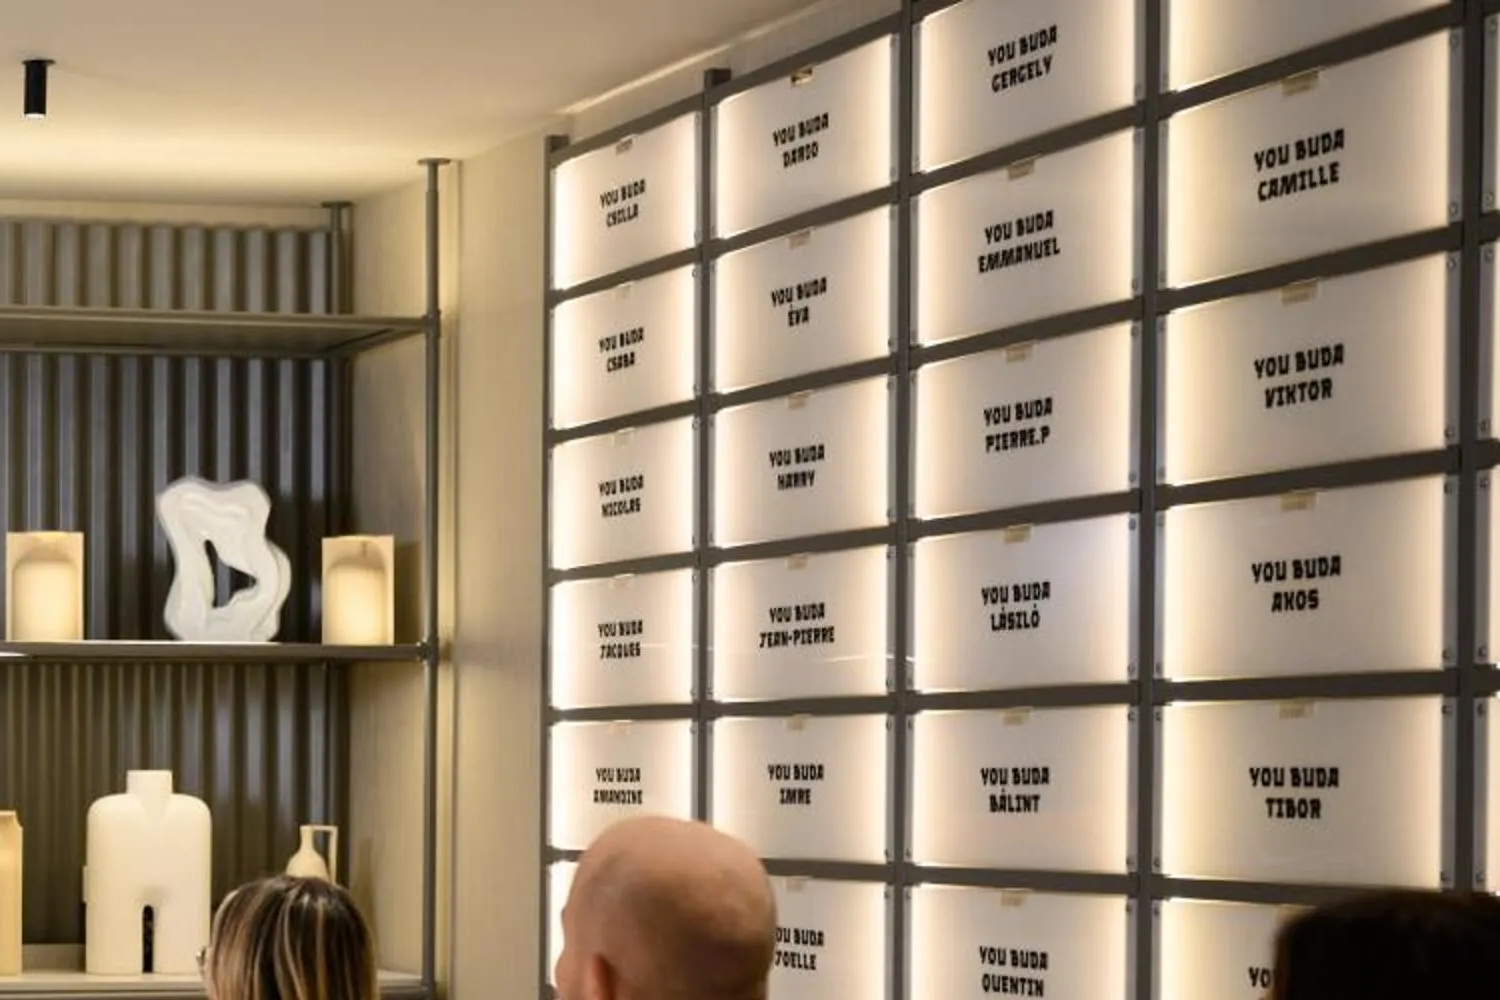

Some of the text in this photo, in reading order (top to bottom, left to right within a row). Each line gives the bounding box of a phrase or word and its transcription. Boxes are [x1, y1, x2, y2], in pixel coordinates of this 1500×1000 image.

[987, 24, 1057, 67] YOU BUDA
[991, 54, 1053, 93] GERGELY
[772, 112, 829, 147] YOU BUDA
[1253, 128, 1345, 172] YOU BUDA
[1257, 161, 1340, 202] CAMILLE
[600, 189, 619, 208] YOU
[984, 210, 1054, 245] YOU BUDA
[977, 236, 1061, 274] EMMANUEL
[771, 276, 827, 307] YOU BUDA
[599, 335, 617, 352] YOU
[1253, 343, 1344, 380] YOU BUDA
[1264, 377, 1333, 409] VIKTOR
[983, 397, 1053, 427] YOU BUDA
[985, 425, 1050, 453] PIERRE.P
[769, 443, 825, 468] YOU BUDA
[599, 480, 617, 496] YOU
[777, 470, 815, 491] HARRY
[1251, 554, 1341, 584] YOU BUDA
[981, 581, 1051, 606] YOU BUDA
[769, 602, 825, 624] YOU BUDA
[598, 623, 617, 638] YOU
[759, 625, 835, 649] JEAN-PIERRE
[596, 768, 614, 783] YOU
[767, 763, 824, 781] YOU BUDA
[980, 766, 1050, 786] YOU BUDA
[1249, 767, 1339, 789] YOU BUDA
[779, 788, 811, 805] IMRE
[1265, 797, 1322, 819] TIBOR
[775, 926, 824, 946] OU BUDA
[775, 949, 817, 970] JOELLE
[979, 945, 1048, 971] YOU BUDA
[981, 973, 1044, 998] QUENTIN
[1248, 966, 1272, 988] YO
